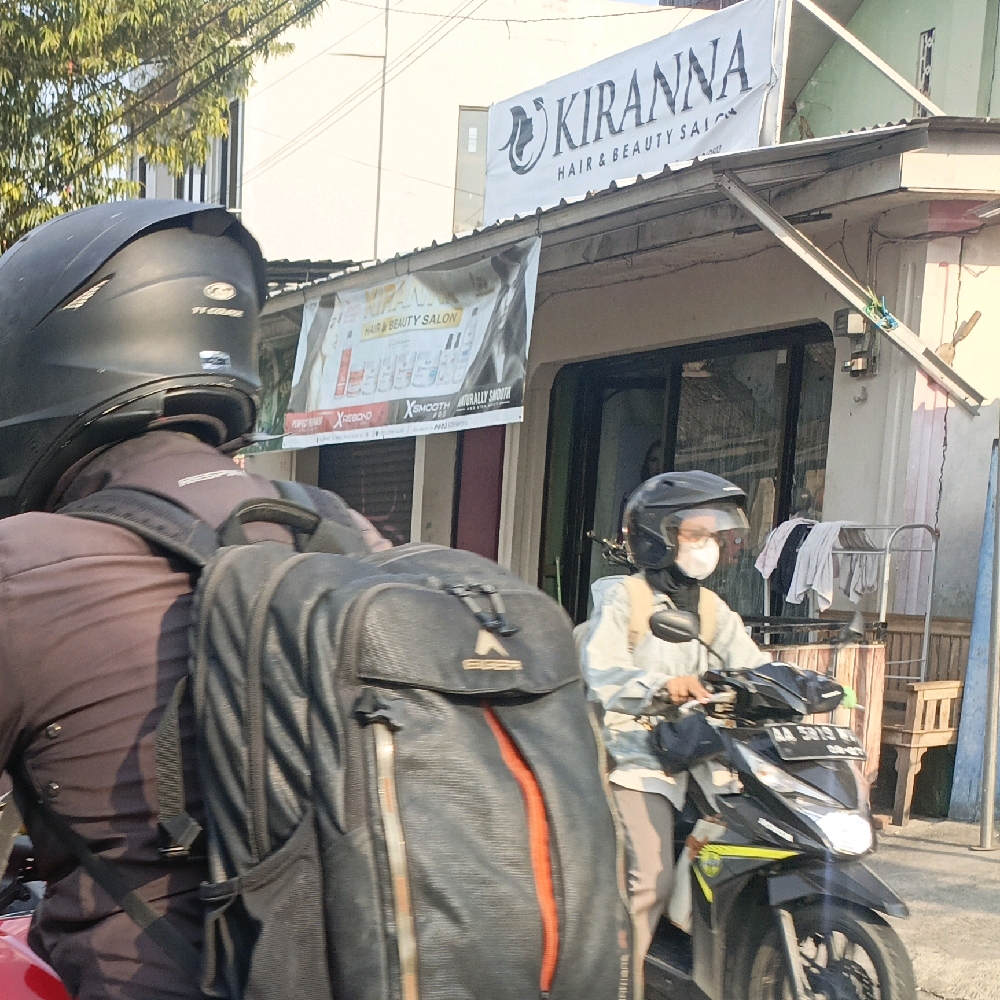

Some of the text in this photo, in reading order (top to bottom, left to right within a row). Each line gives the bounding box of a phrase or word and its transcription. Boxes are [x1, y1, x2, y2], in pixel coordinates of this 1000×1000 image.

[553, 28, 752, 157] KIRANNA
[558, 157, 592, 181] HAIR
[599, 153, 606, 167] &
[612, 129, 673, 162] BEAUTY
[364, 323, 382, 336] HAIR
[388, 314, 421, 331] BEAUTY
[421, 313, 458, 326] SALON
